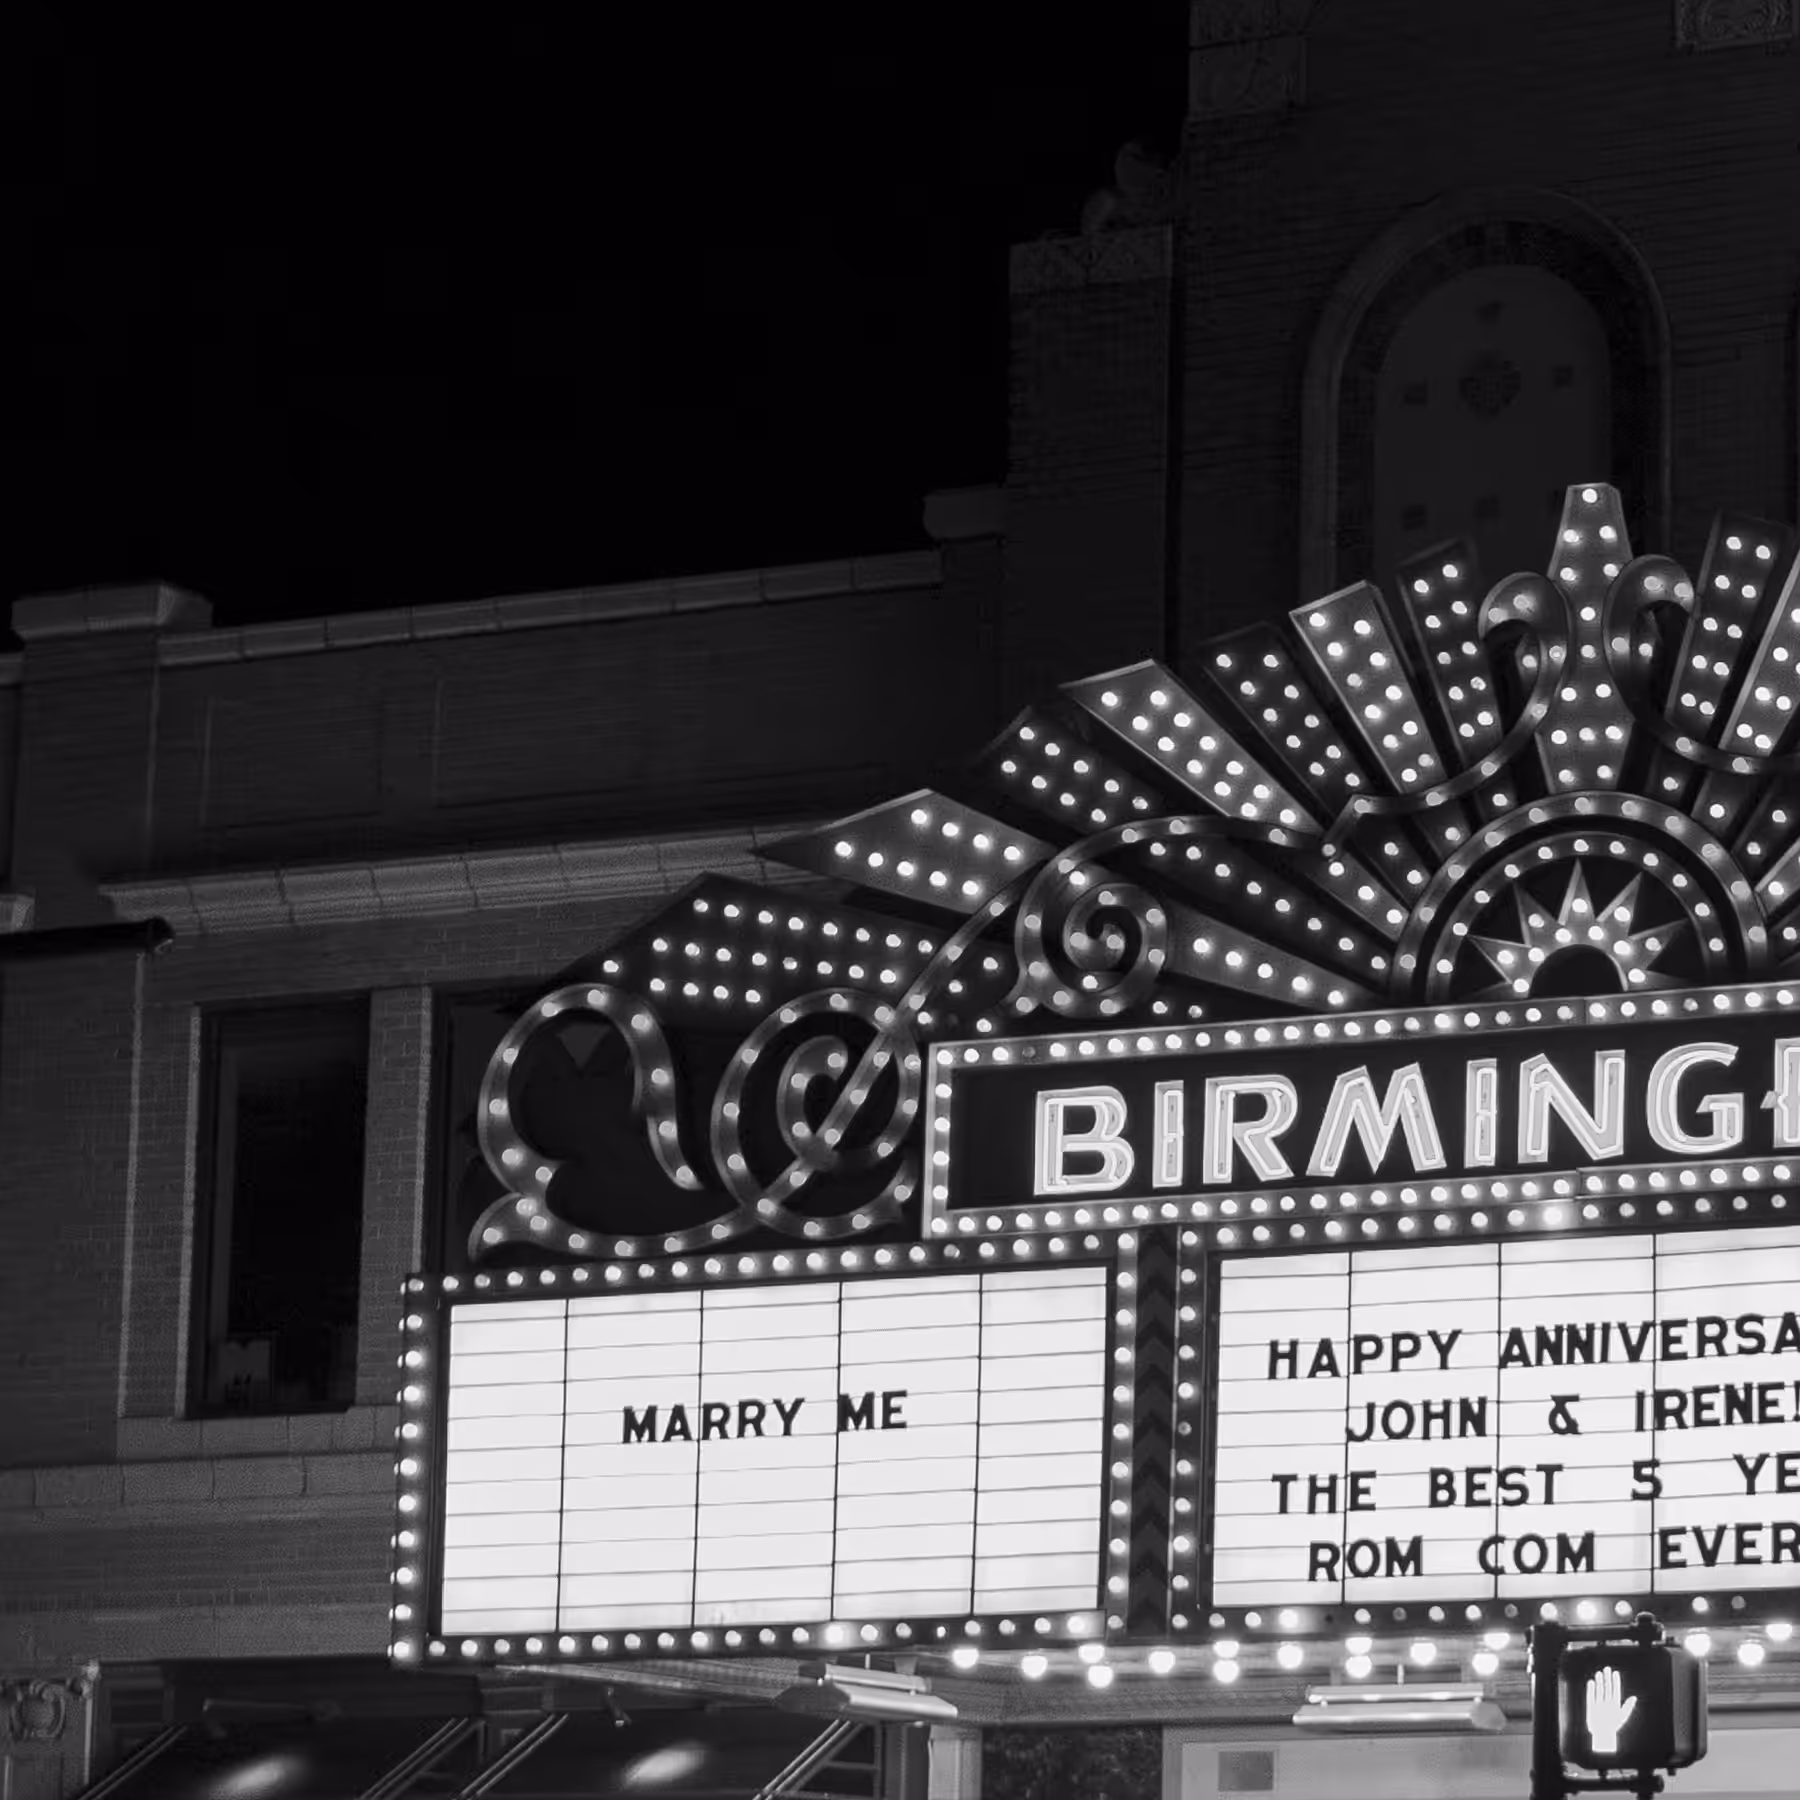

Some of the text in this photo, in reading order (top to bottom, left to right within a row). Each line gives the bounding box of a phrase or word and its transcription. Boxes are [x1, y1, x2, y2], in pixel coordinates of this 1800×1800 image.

[1268, 1329, 1460, 1381] HAPPY
[622, 1390, 907, 1445] MARRY ME
[1345, 1396, 1488, 1443] JOHN
[1547, 1394, 1580, 1436] &
[1271, 1470, 1377, 1515] THE
[1429, 1463, 1563, 1509] BEST
[1631, 1458, 1663, 1502] 5
[1308, 1536, 1423, 1583] ROM
[1477, 1531, 1595, 1577] COM
